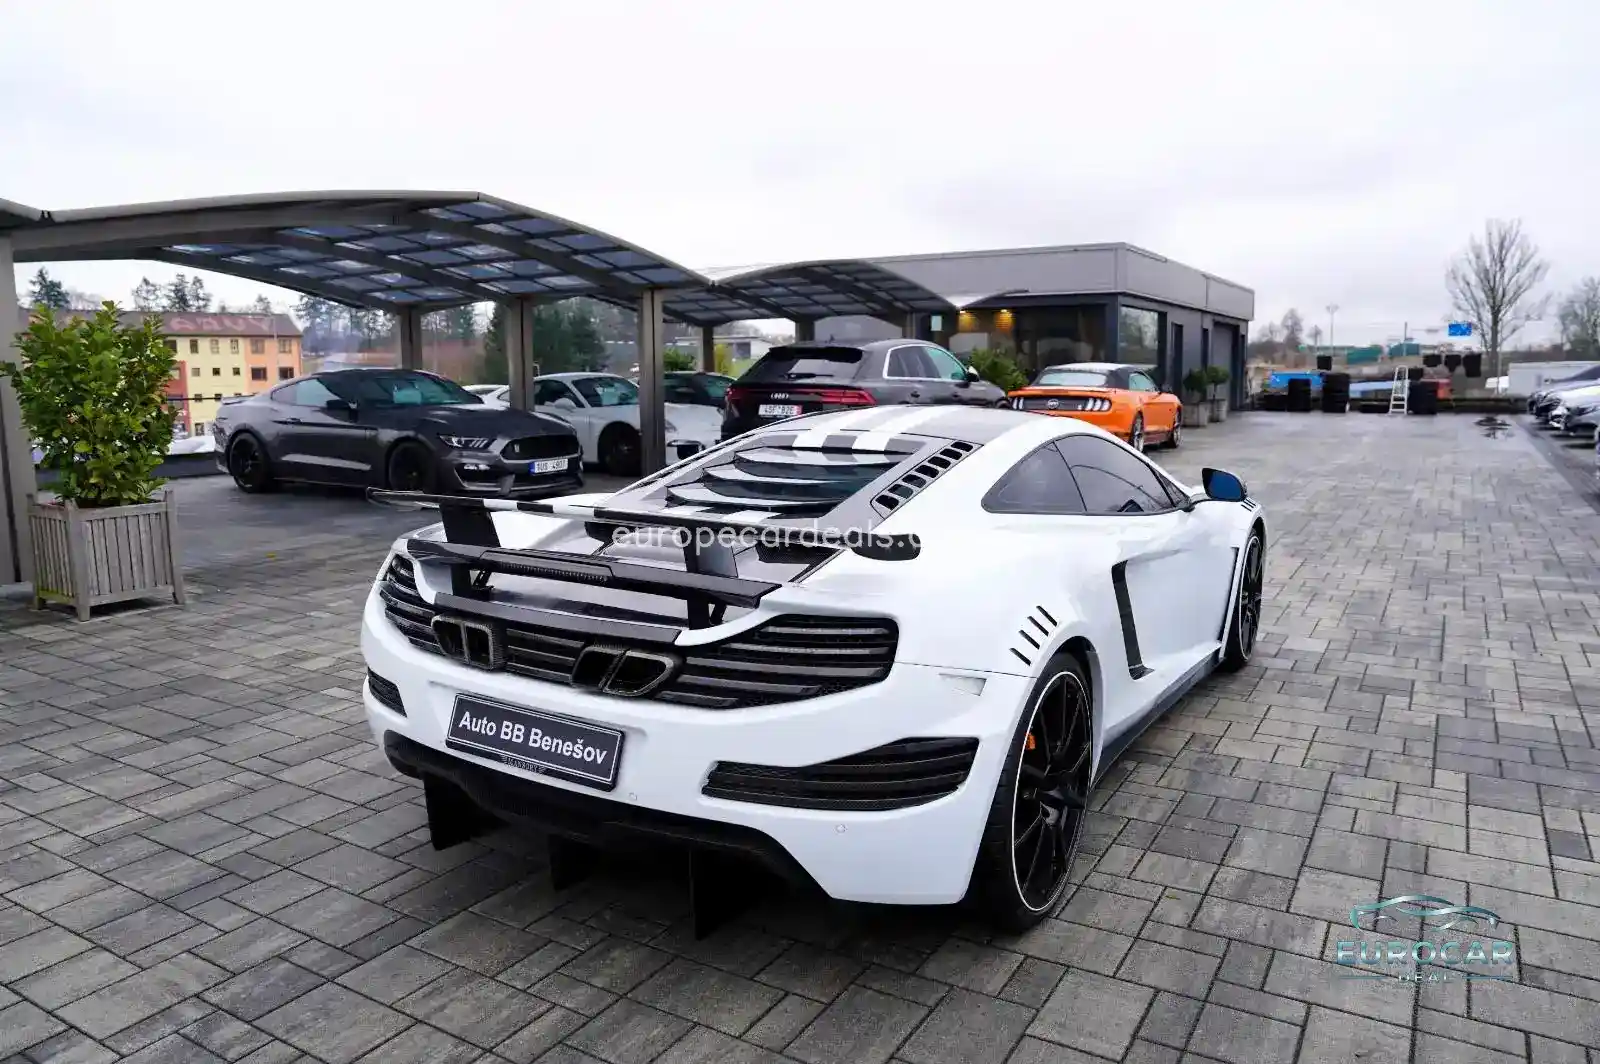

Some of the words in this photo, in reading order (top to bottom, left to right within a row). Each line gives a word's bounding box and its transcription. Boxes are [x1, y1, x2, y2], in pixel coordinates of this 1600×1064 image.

[459, 711, 497, 736] Auto
[500, 721, 525, 743] BB
[528, 727, 608, 764] Benešov
